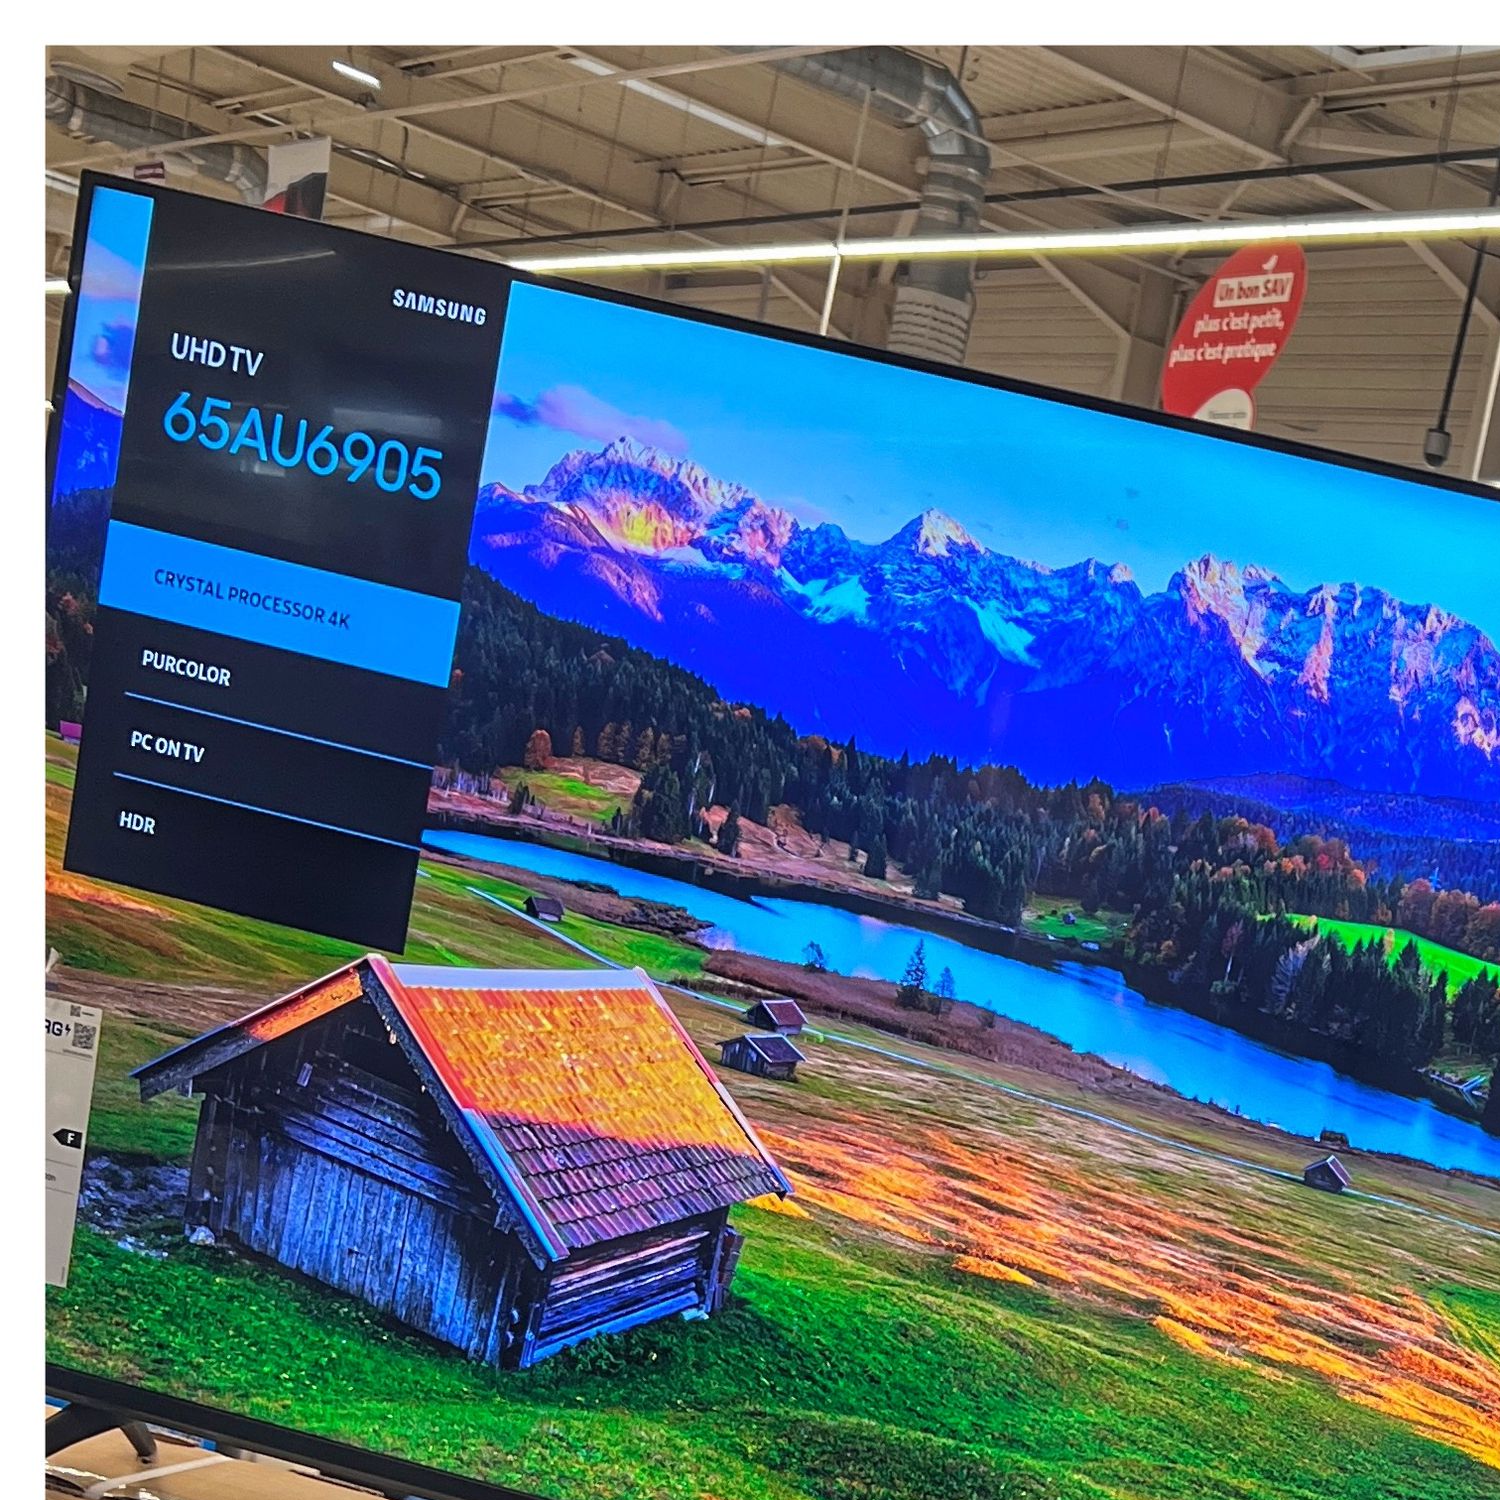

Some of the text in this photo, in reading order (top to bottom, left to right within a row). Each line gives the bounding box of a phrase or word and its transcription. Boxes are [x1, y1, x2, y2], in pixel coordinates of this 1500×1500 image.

[1236, 280, 1260, 300] bon
[1261, 277, 1292, 298] SAV
[392, 288, 487, 326] SAMSUNG
[1193, 314, 1221, 338] plus
[170, 332, 265, 377] UHD TV
[1168, 343, 1197, 368] plus
[1222, 338, 1277, 365] pratique
[162, 391, 444, 500] 65AU6905
[153, 568, 352, 630] CRYSTAL PROCESSOR 4K
[141, 648, 232, 688] PURCOLOR
[130, 730, 206, 764] PC ON TV
[119, 810, 156, 836] HDR
